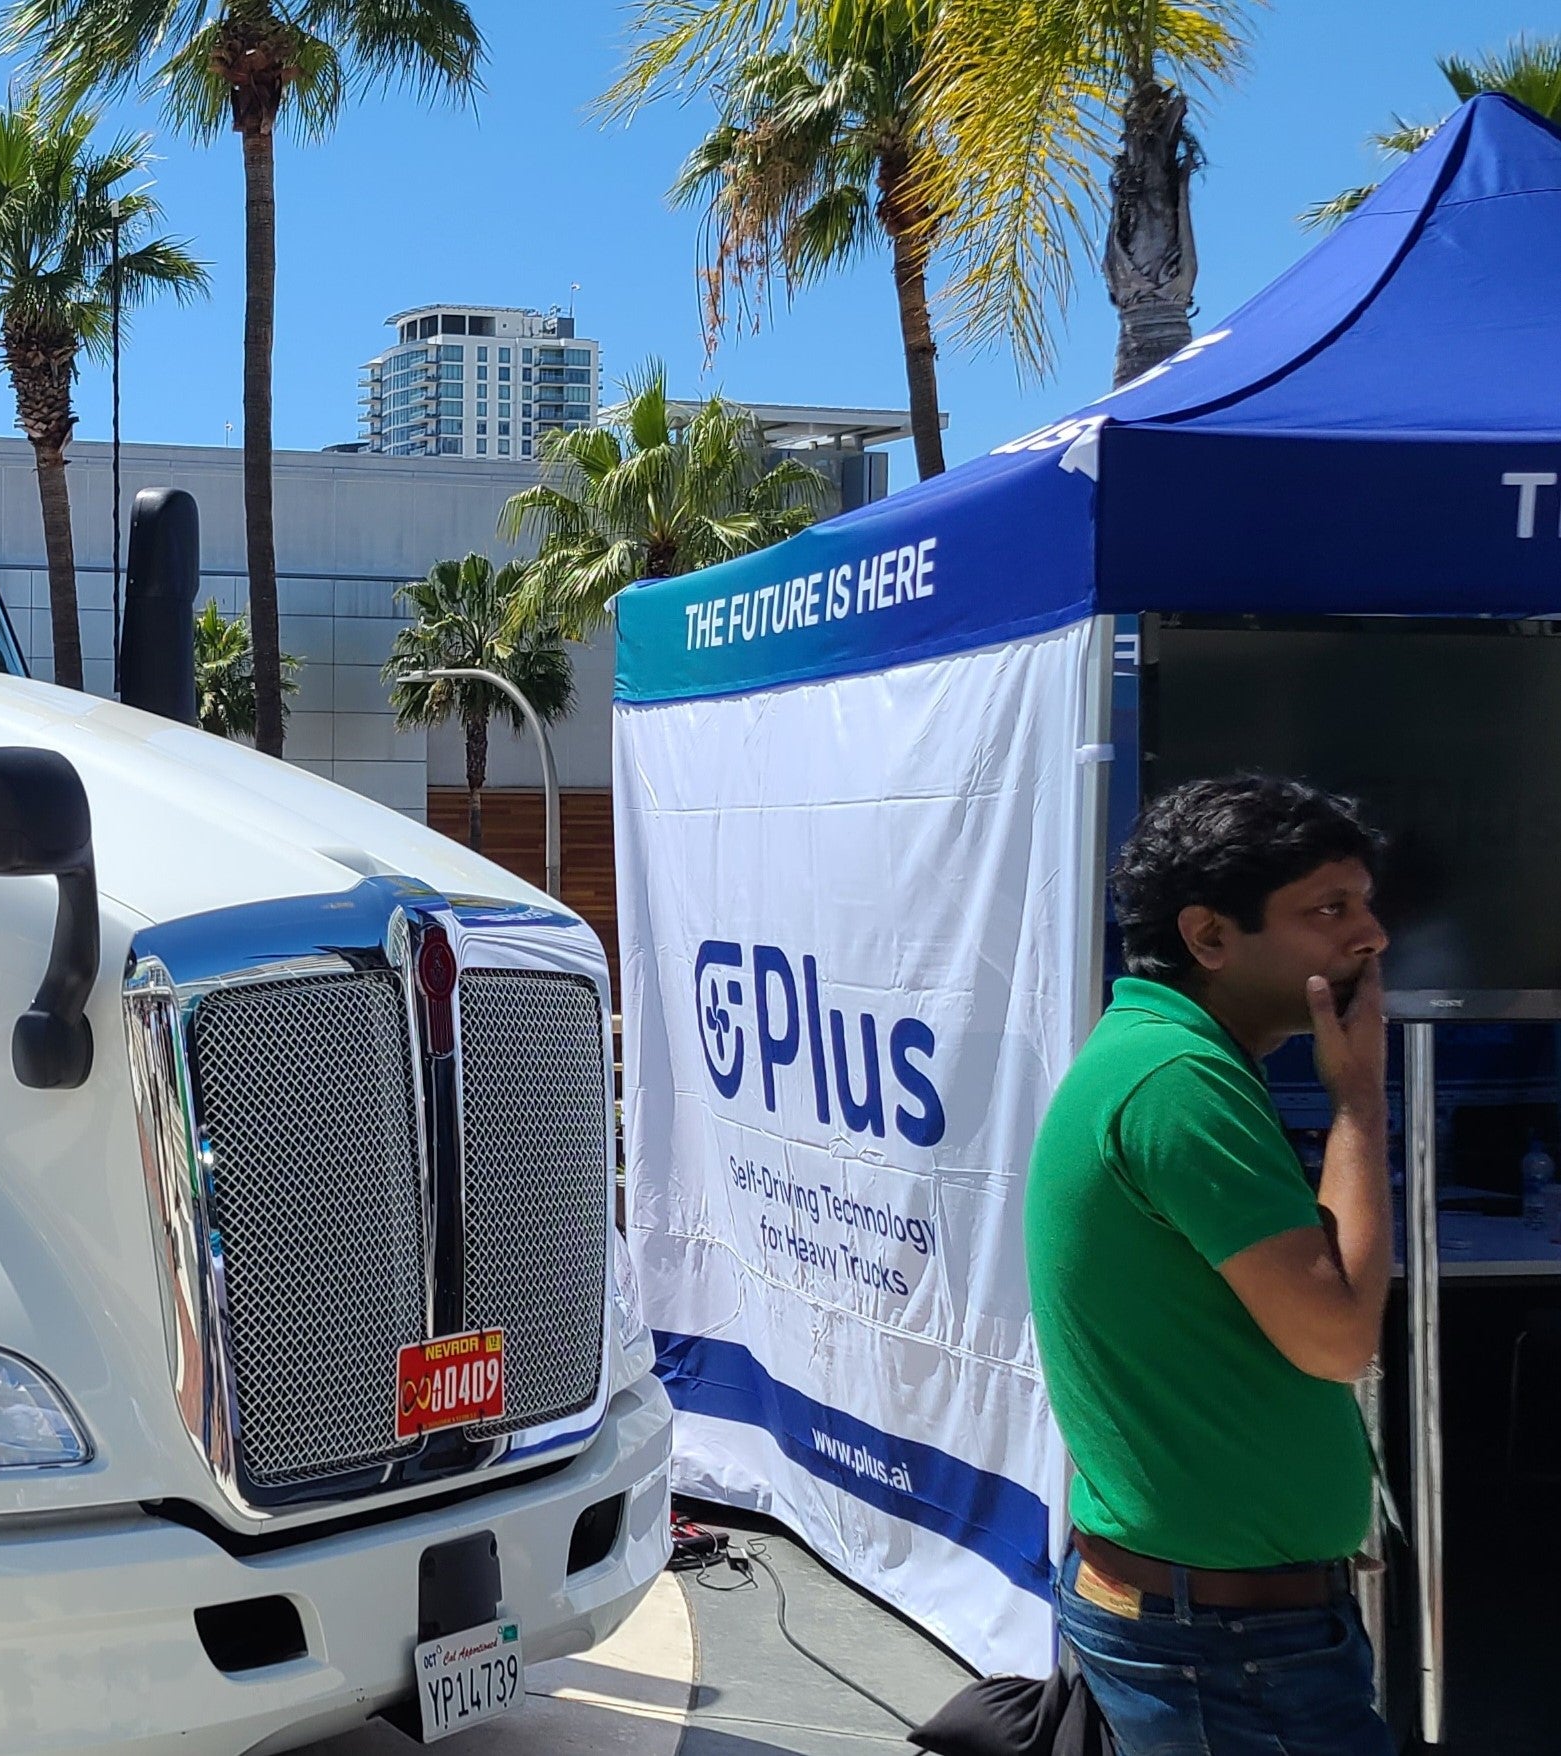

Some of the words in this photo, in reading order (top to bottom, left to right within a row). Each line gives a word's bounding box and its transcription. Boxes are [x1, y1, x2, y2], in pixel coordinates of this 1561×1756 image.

[685, 598, 726, 651] THE
[727, 571, 823, 645] FUTURE
[825, 563, 852, 622] IS
[856, 537, 937, 614] HERE
[752, 944, 946, 1148] Plus
[729, 1155, 820, 1225] Self-Driving
[820, 1184, 937, 1257] Technology
[760, 1214, 784, 1253] for
[785, 1224, 838, 1282] Heavy
[840, 1242, 909, 1296] Trucks
[425, 1336, 479, 1361] NEVADA
[811, 1427, 913, 1493] www.plus.ai
[424, 1653, 437, 1669] OCT
[443, 1651, 457, 1666] Cal
[428, 1654, 518, 1727] YP14739
